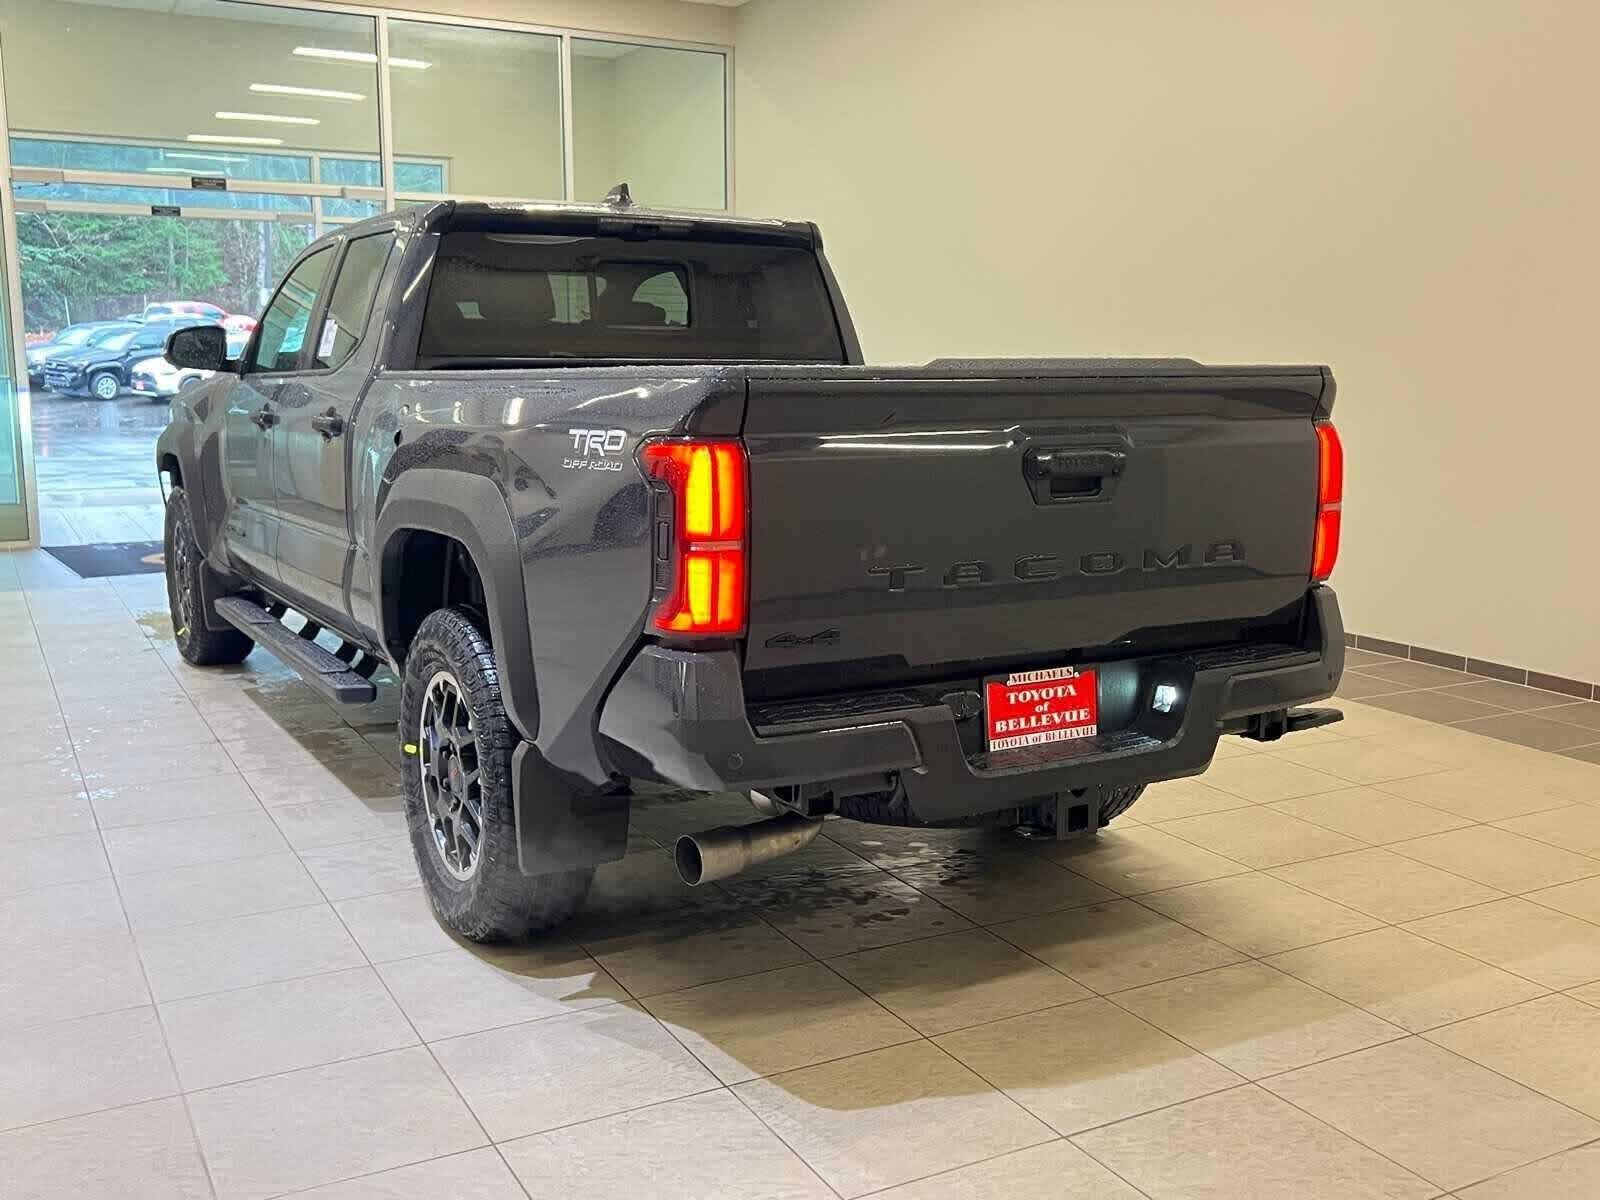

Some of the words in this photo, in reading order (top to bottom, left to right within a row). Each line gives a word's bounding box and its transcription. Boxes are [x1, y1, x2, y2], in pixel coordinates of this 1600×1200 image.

[568, 428, 627, 456] TRD
[562, 457, 588, 470] OFF
[588, 459, 623, 471] ROAD
[866, 538, 1249, 592] TACOMA
[1011, 667, 1073, 683] MICHAELS
[1006, 684, 1077, 704] TOYOTA
[1034, 701, 1050, 713] of
[995, 708, 1090, 733] BELLEVUE
[991, 735, 1030, 750] TOYOTA
[1045, 726, 1095, 742] BELLEVUE
